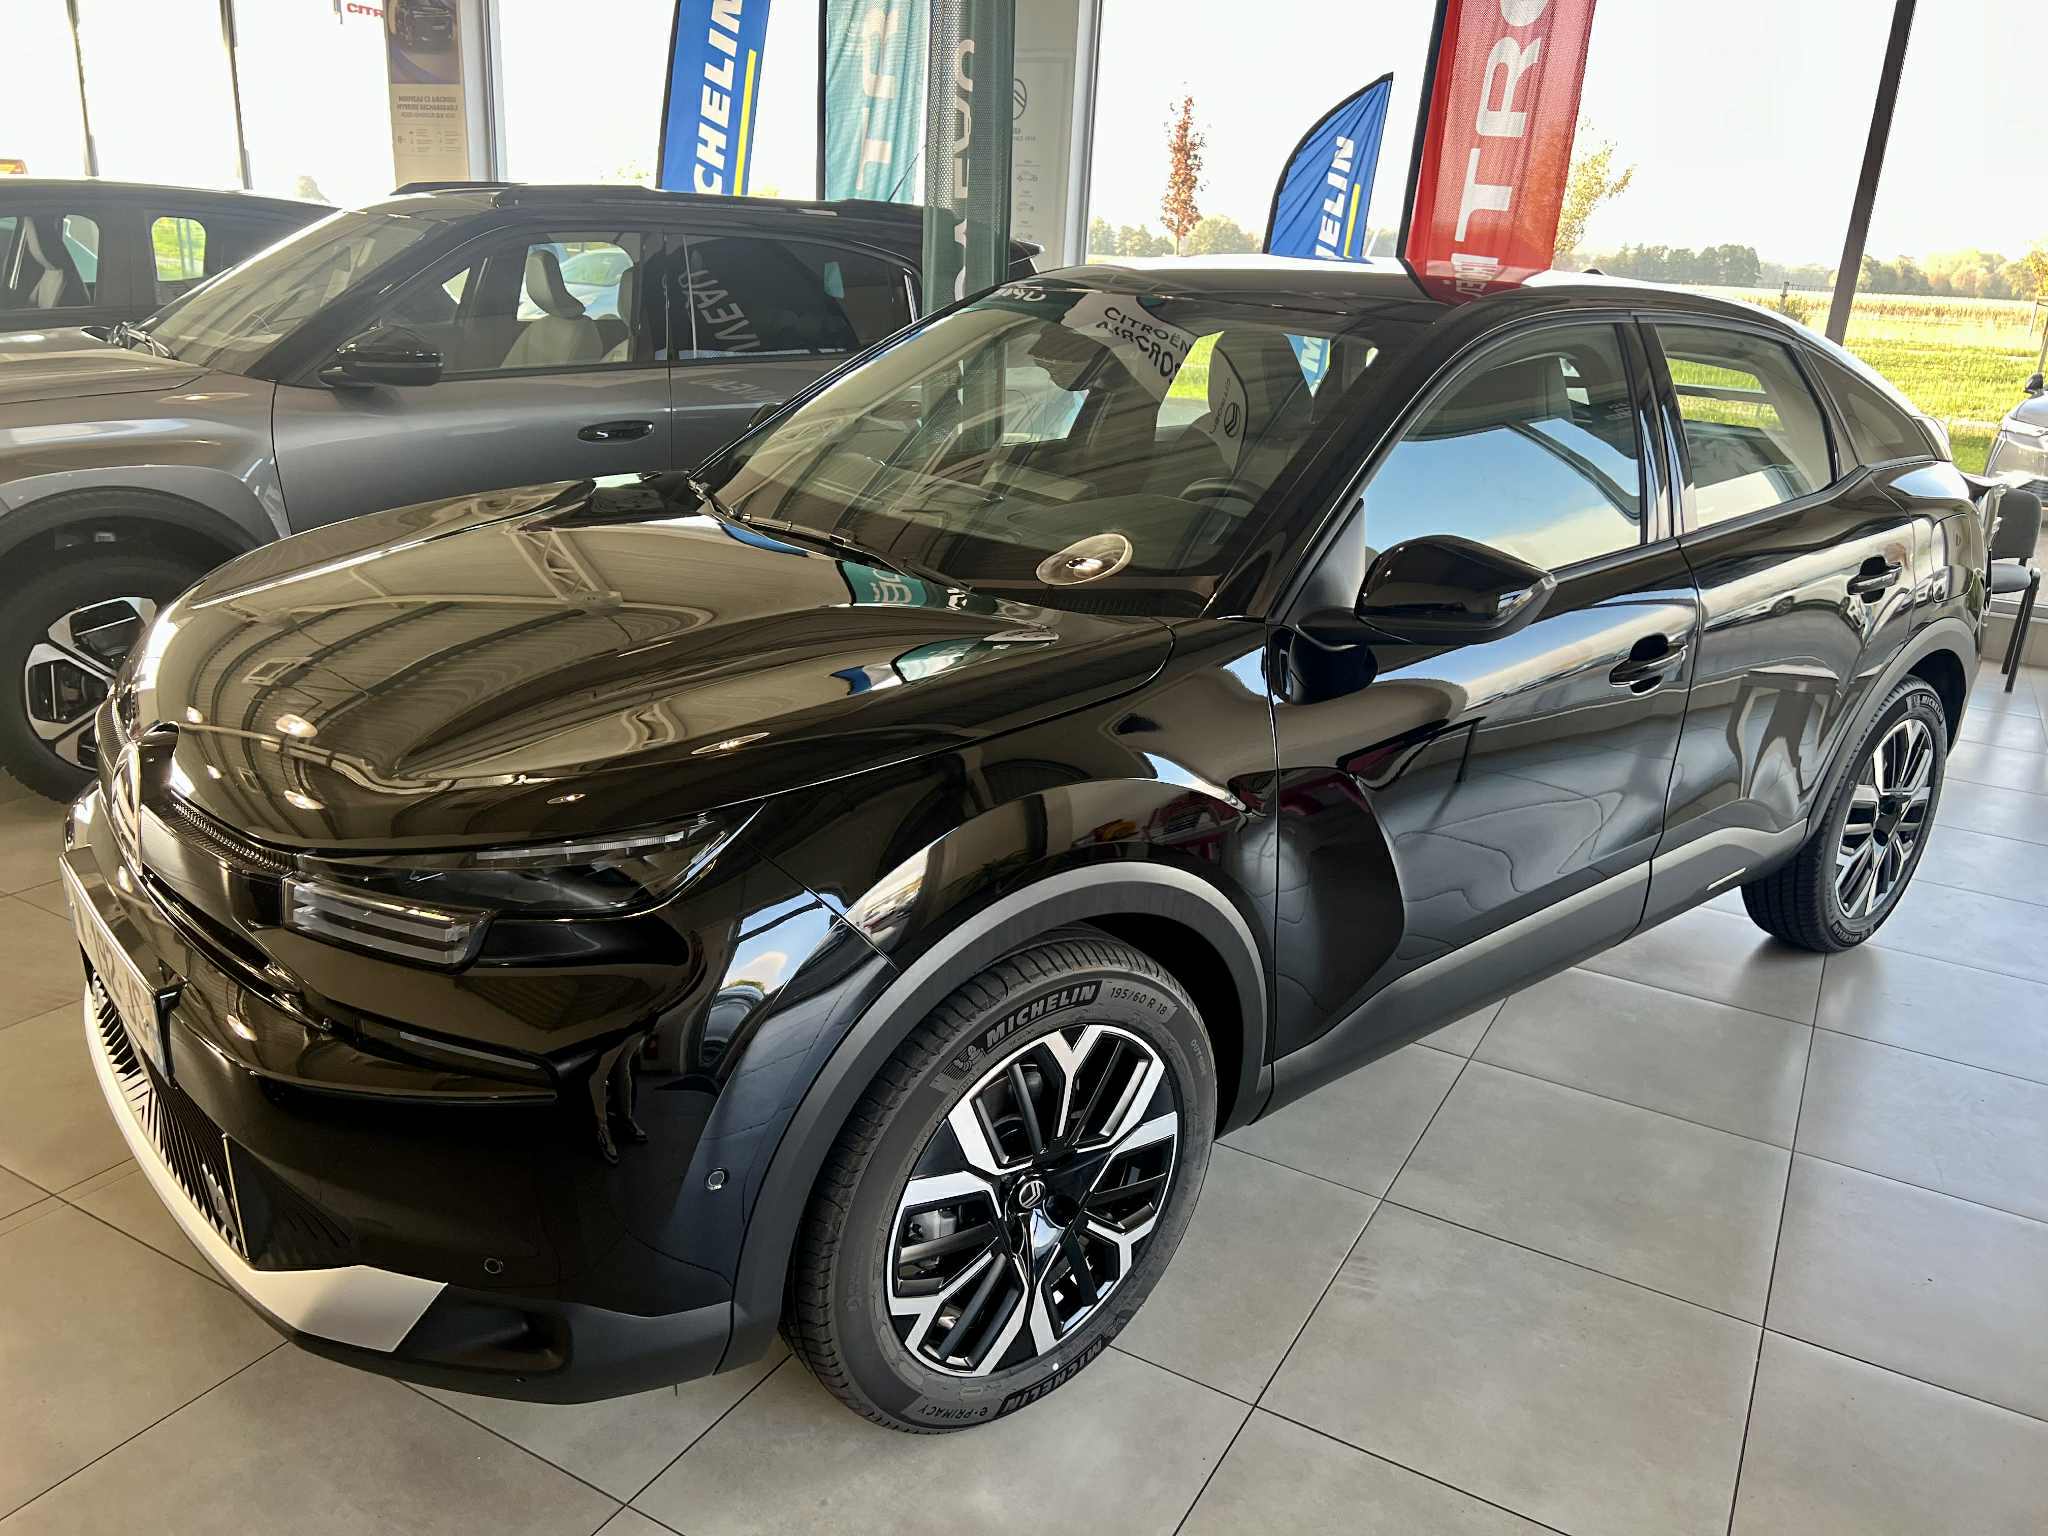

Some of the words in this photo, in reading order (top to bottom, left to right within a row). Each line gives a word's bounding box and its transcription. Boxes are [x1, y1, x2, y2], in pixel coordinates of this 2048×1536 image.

[986, 984, 1096, 1049] MICHELIN
[1110, 986, 1147, 1004] 195/60
[1147, 998, 1156, 1009] R
[1156, 1003, 1168, 1016] 18
